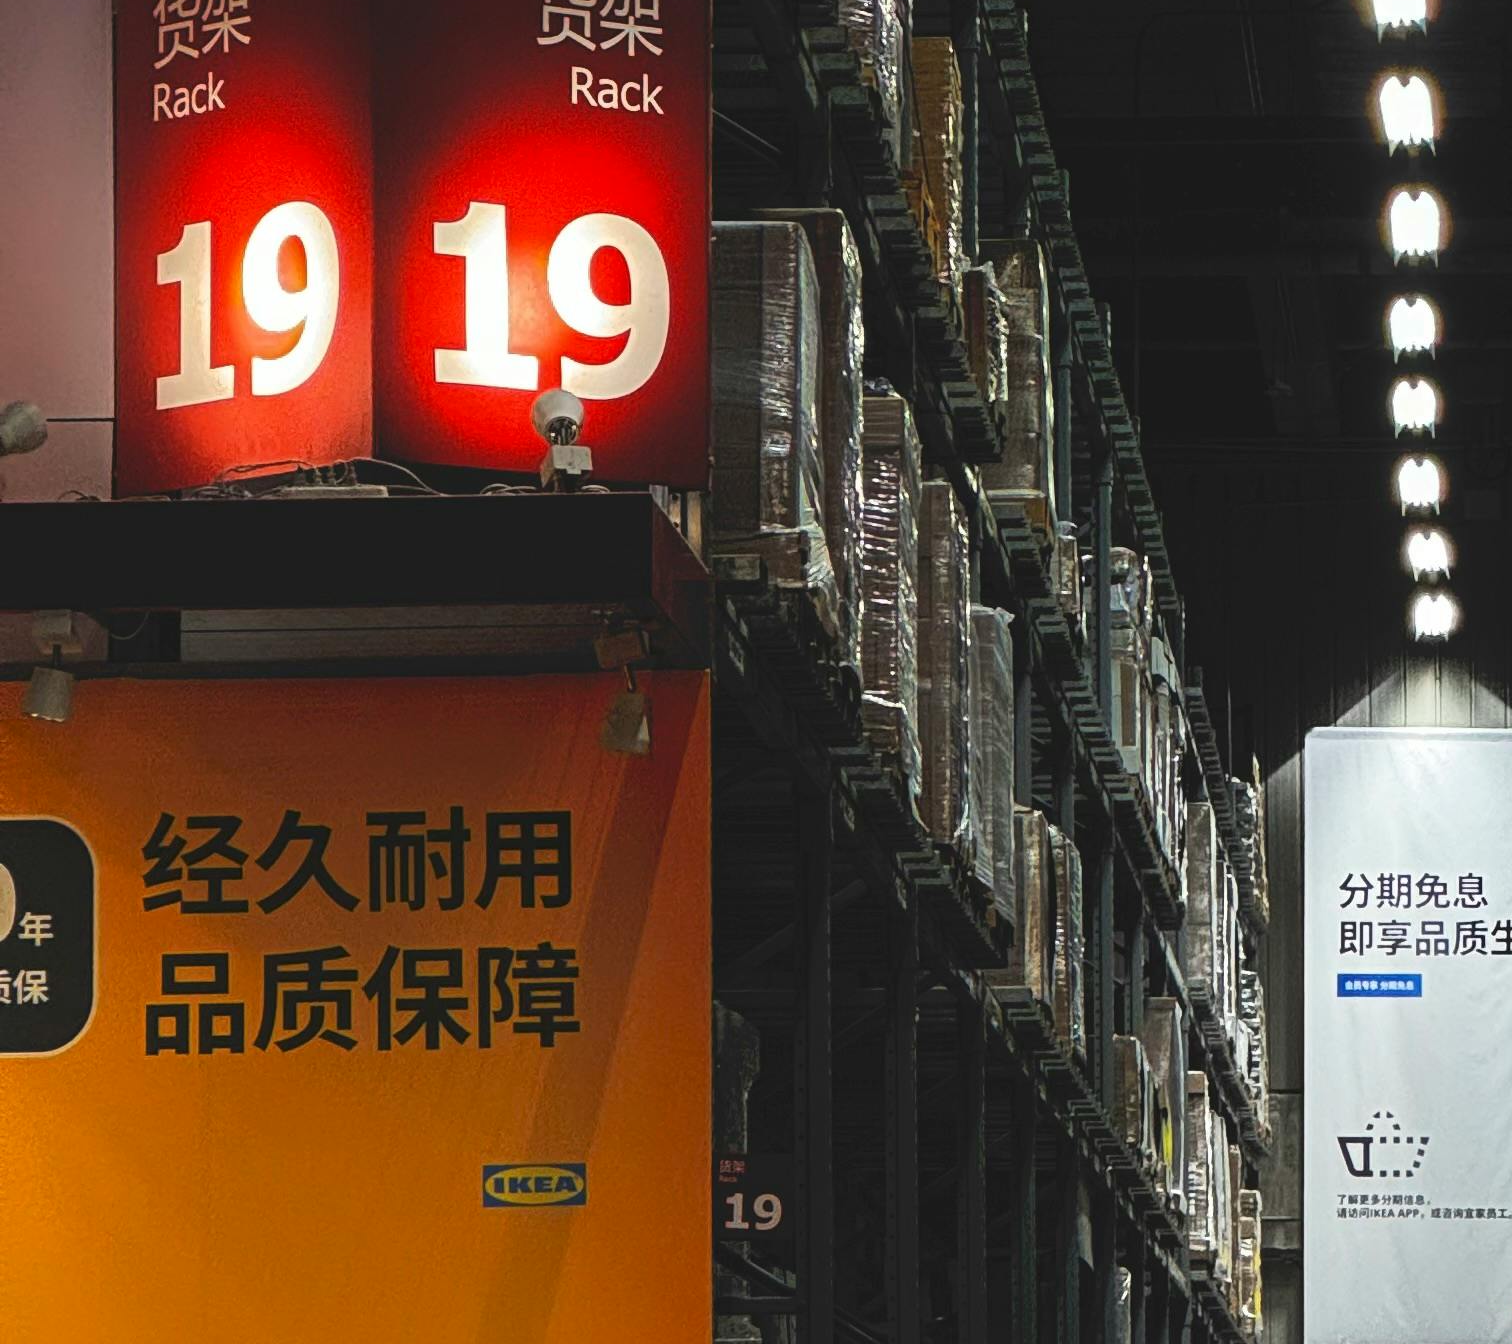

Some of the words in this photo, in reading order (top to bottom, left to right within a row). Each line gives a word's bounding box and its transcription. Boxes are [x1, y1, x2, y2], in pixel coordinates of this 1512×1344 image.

[153, 71, 225, 122] Rack
[571, 66, 664, 115] Rack
[156, 200, 340, 410] 19
[433, 201, 671, 400] 19
[142, 805, 573, 914] 经久耐用
[1339, 873, 1488, 908] 分期免息
[145, 941, 580, 1056] 品质保障
[493, 1175, 578, 1194] IKEA
[725, 1192, 782, 1230] 19
